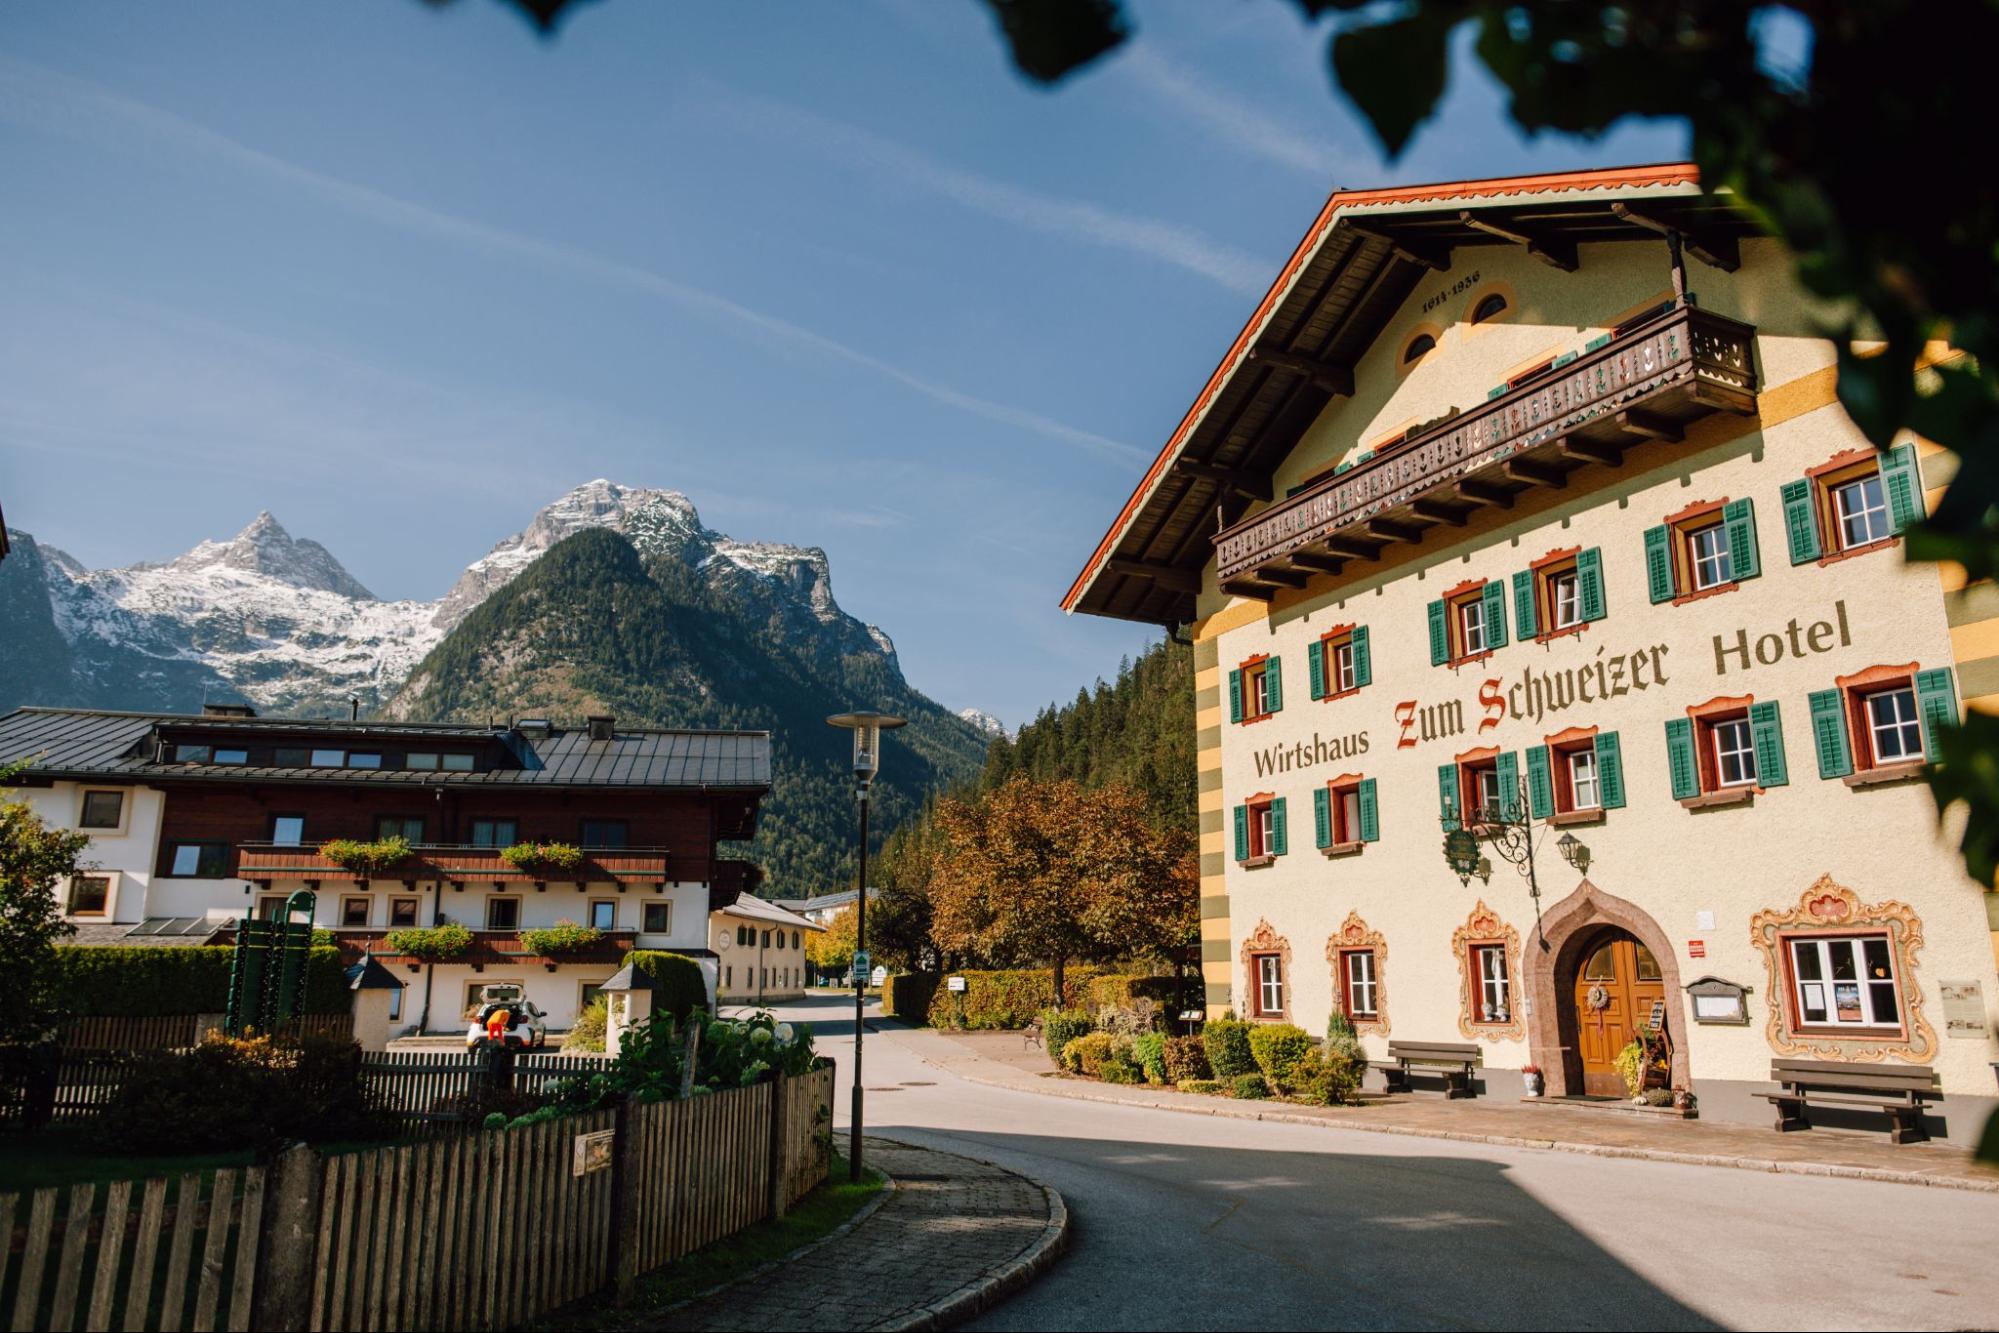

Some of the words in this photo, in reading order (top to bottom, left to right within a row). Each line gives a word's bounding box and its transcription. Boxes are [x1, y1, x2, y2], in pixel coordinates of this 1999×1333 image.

[1254, 730, 1370, 778] Wirtshaus
[1395, 699, 1465, 750] Zum
[1478, 643, 1670, 735] Schweizer
[1712, 599, 1851, 675] Hotel
